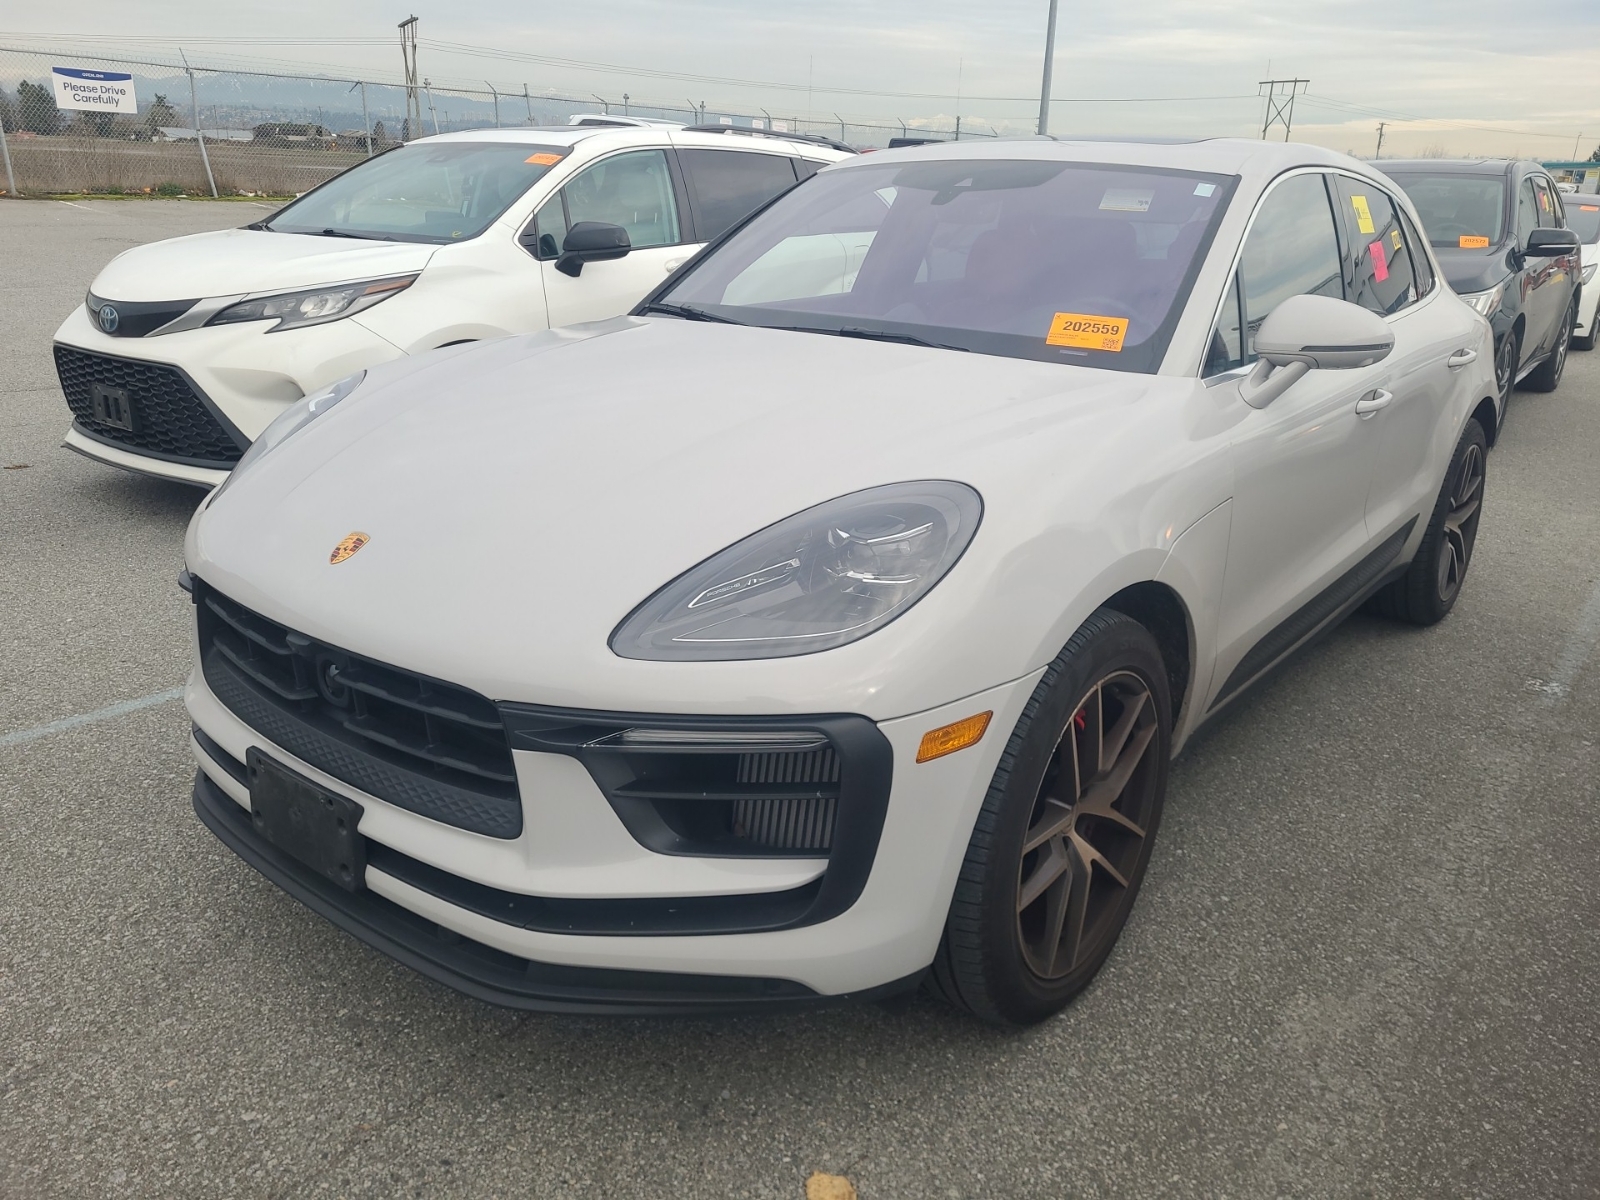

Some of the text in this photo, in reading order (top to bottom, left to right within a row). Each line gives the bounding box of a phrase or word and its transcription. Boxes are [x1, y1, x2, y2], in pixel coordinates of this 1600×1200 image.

[63, 82, 126, 95] Please Drive
[73, 93, 120, 108] Carefully
[1062, 320, 1120, 336] 202559
